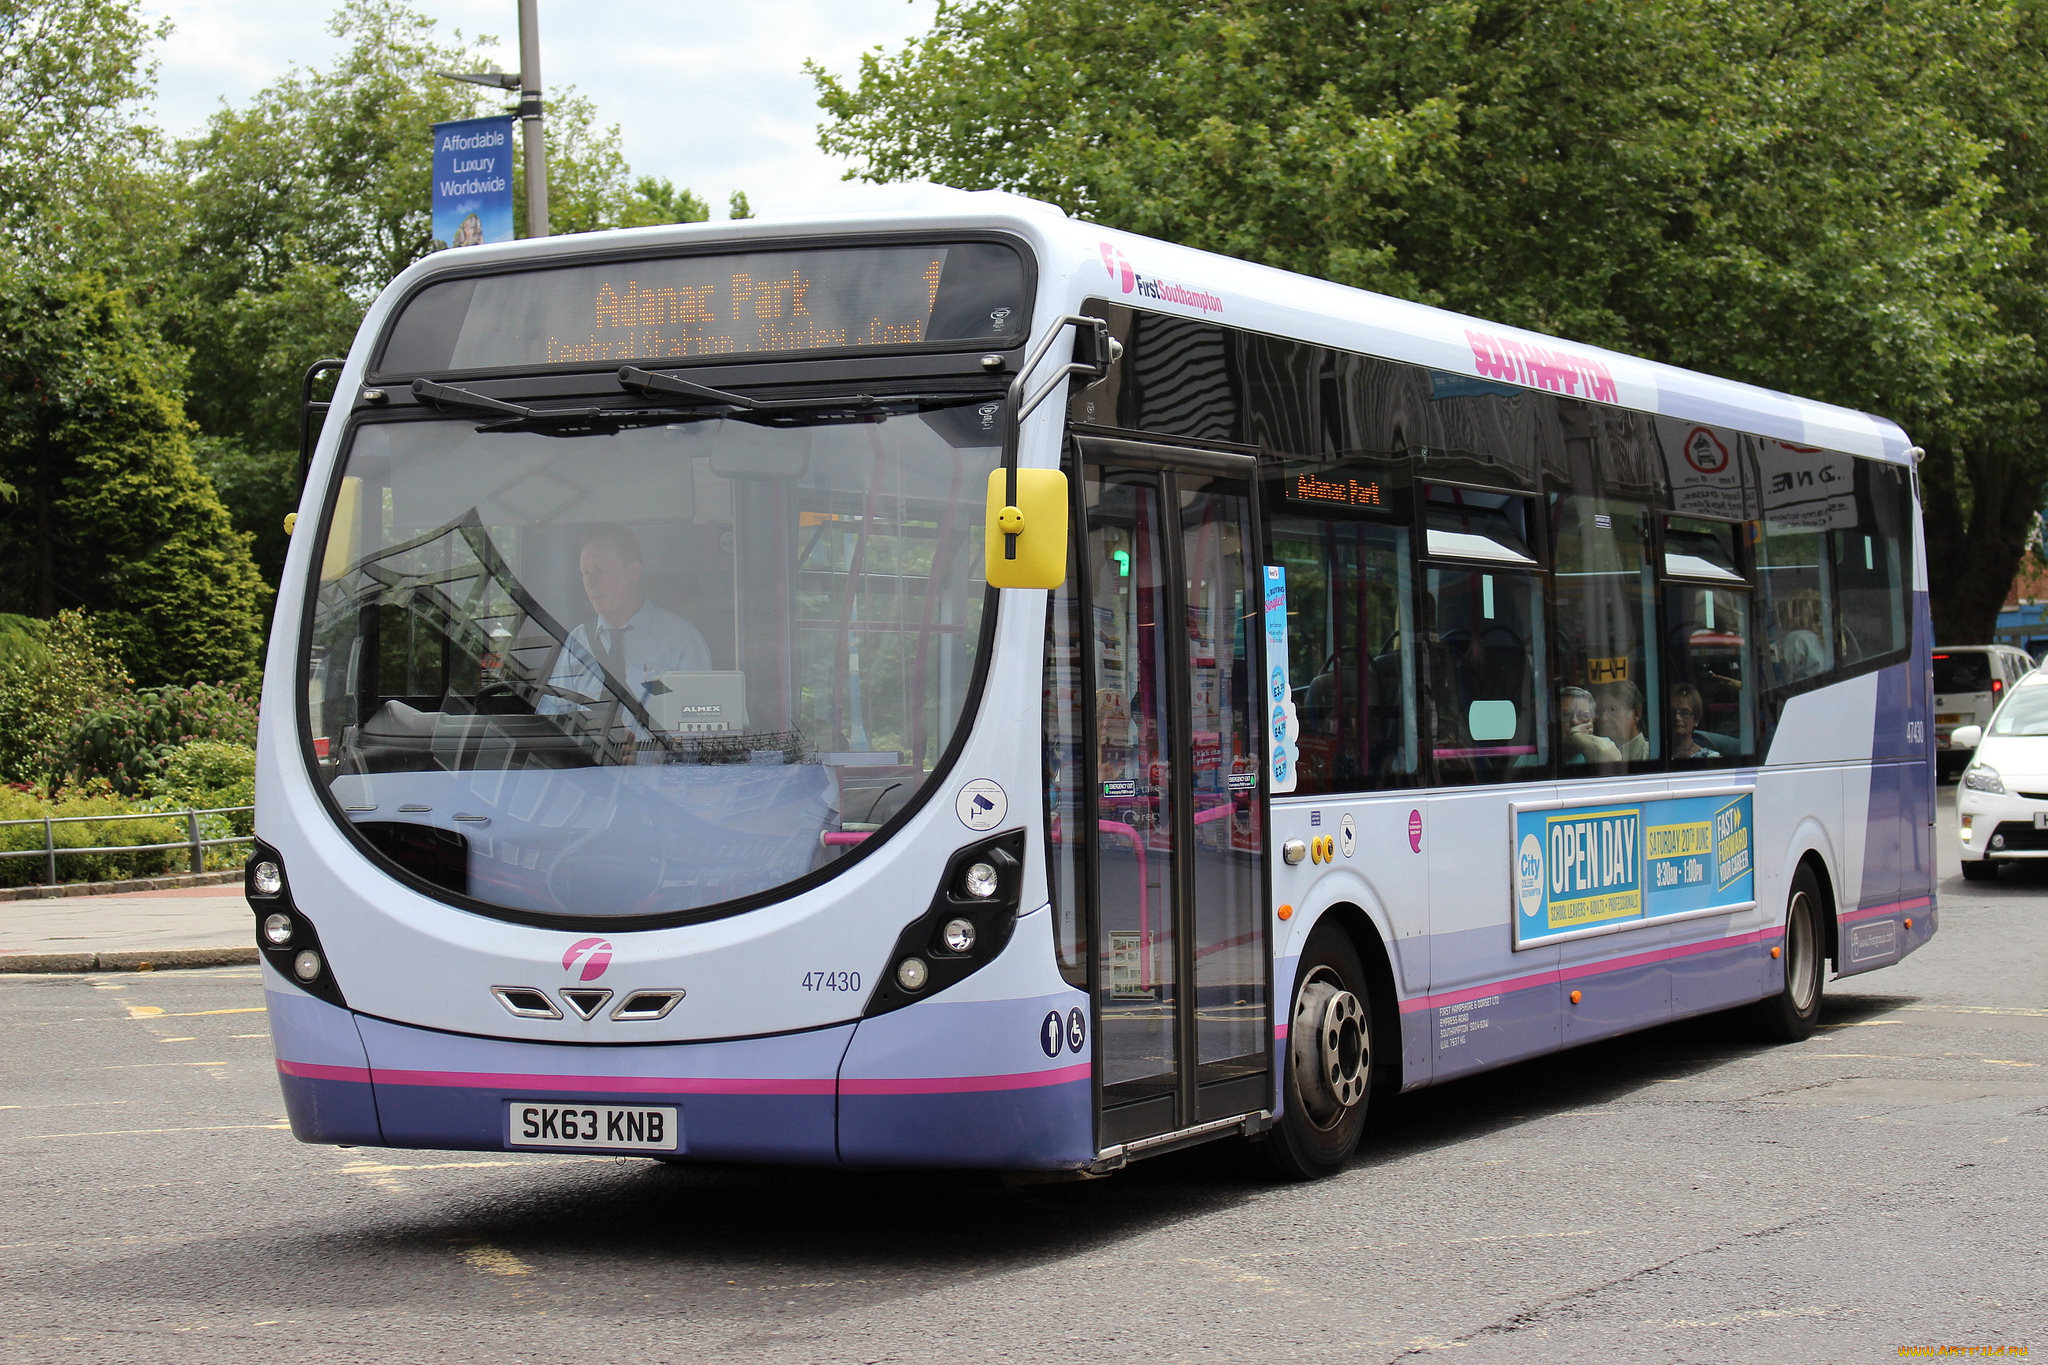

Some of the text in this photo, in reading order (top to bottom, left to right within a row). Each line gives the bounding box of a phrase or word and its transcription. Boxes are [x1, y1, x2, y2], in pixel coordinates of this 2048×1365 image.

[441, 131, 505, 152] Affordable
[453, 157, 496, 174] Luxury
[440, 176, 506, 197] Worldwide
[596, 269, 810, 328] Adanac Park
[1464, 329, 1619, 404] SOUTHAMPTON
[1297, 472, 1381, 505] Adanac Park
[683, 705, 721, 713] ALMEX
[1649, 829, 1681, 856] SATURDAY
[1696, 826, 1709, 851] JUNE
[1717, 808, 1734, 841] FAST
[1551, 817, 1636, 894] OPEN DAY
[1718, 827, 1748, 864] FORWARD
[1521, 854, 1541, 880] City
[1720, 849, 1749, 883] YOUR CAREER
[801, 971, 861, 992] 47430
[522, 1108, 664, 1143] SK63 KNB
